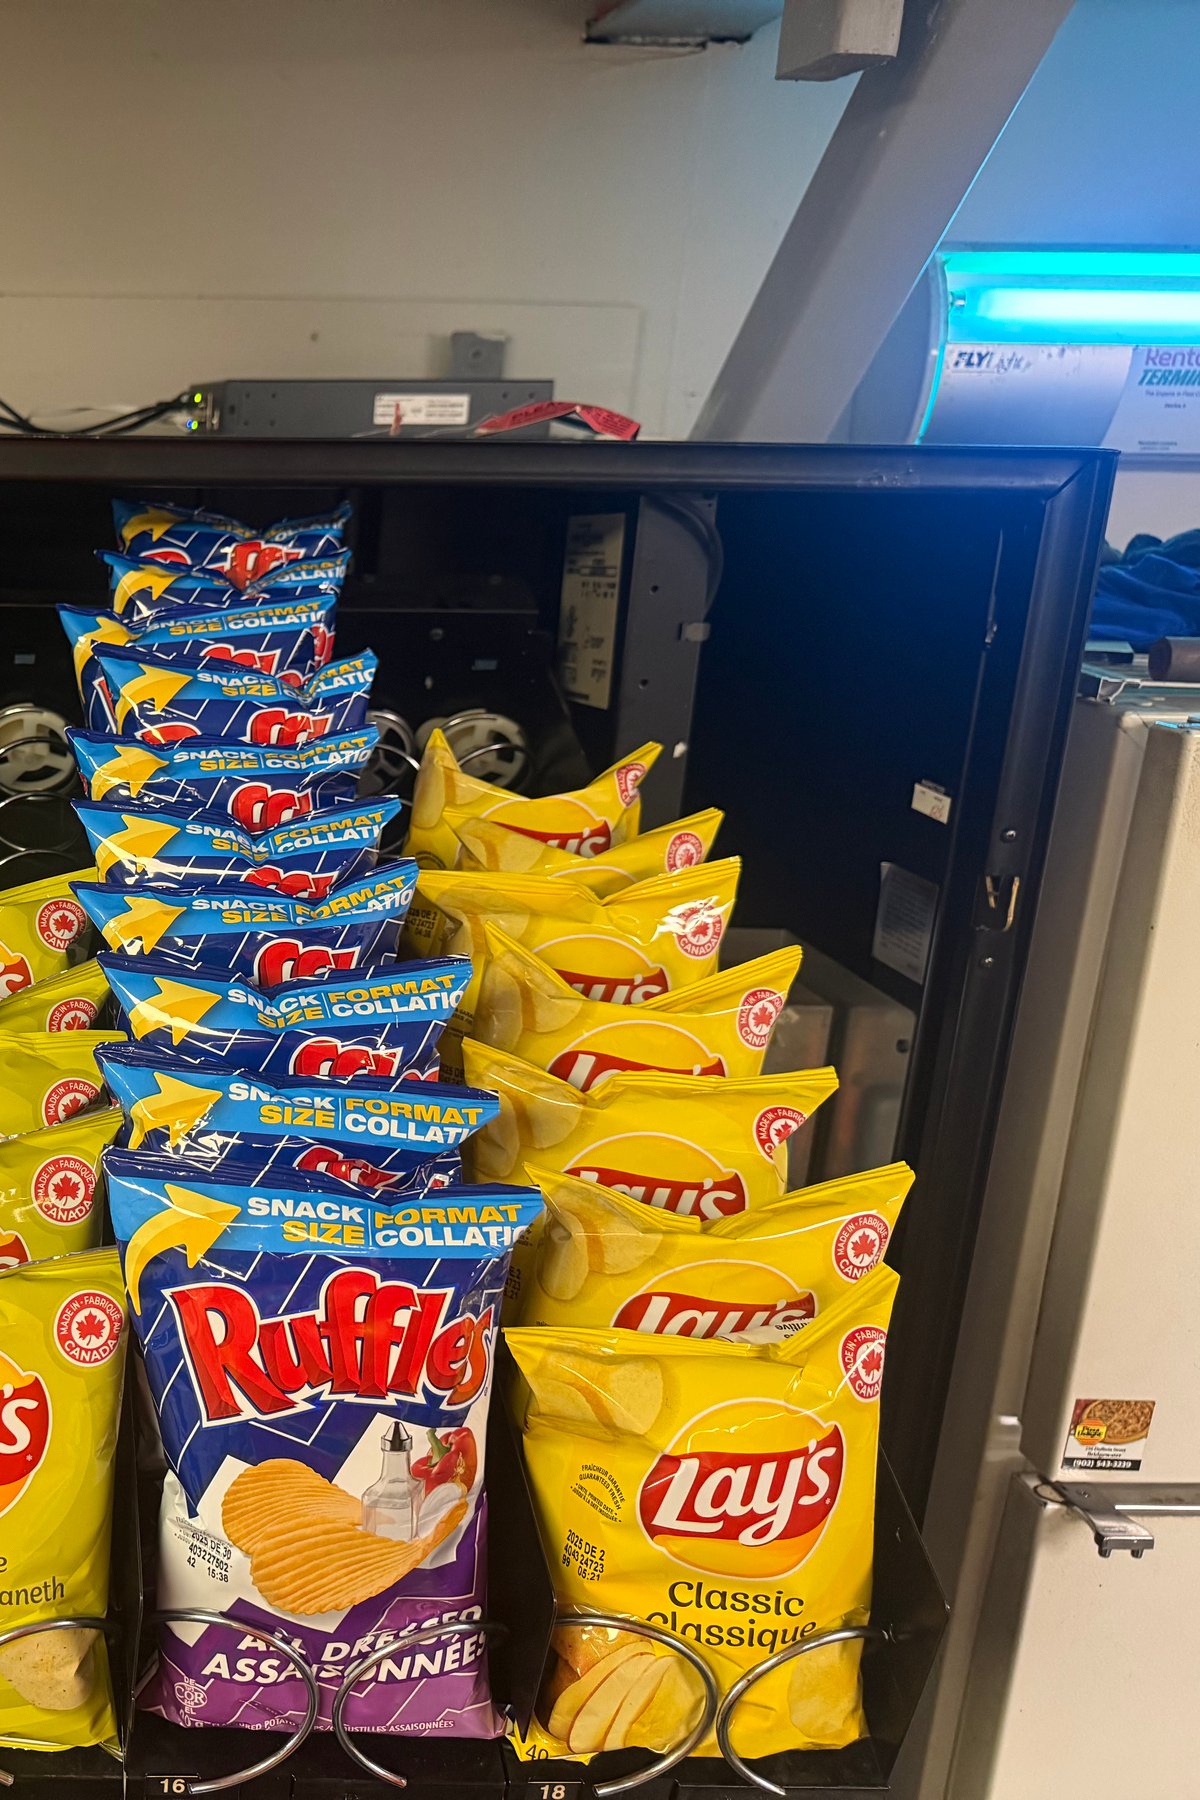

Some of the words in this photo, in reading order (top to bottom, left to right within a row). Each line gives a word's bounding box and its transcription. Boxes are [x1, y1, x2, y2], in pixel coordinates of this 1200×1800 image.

[225, 602, 322, 622] FORMAT
[169, 622, 223, 636] SIZE
[222, 683, 277, 697] SIZE
[173, 750, 257, 764] SNACK
[265, 737, 368, 762] FORMAT
[200, 758, 260, 771] SIZE
[273, 810, 385, 846] FORMAT
[192, 900, 287, 914] SNACK
[295, 875, 408, 920] FORMAT
[221, 910, 288, 925] SIZE
[227, 989, 320, 1019] SNACK
[328, 974, 456, 1004] FORMAT
[257, 1005, 325, 1030] SIZE
[47, 1091, 60, 1116] MADE
[228, 1082, 334, 1110] SNACK
[345, 1098, 483, 1126] FORMAT
[259, 1106, 336, 1129] SIZE
[37, 1168, 51, 1196] MADE
[41, 1199, 93, 1222] CANADA
[247, 1197, 365, 1224] SNACK
[375, 1204, 523, 1230] FORMAT
[282, 1221, 366, 1246] SIZE
[837, 1229, 851, 1256] MADE
[59, 1308, 75, 1335] MADE
[70, 1300, 81, 1312] IN
[84, 1295, 121, 1322] FABRIQUÉ
[113, 1320, 121, 1334] AU
[64, 1338, 118, 1363] CANADA
[168, 1267, 494, 1421] Ruffles
[651, 1438, 836, 1546] Lay's
[210, 1540, 221, 1555] DE
[222, 1546, 232, 1561] 30
[566, 1529, 584, 1551] 2025
[584, 1541, 598, 1559] DE
[598, 1549, 606, 1562] 2
[187, 1555, 197, 1569] 42
[207, 1566, 229, 1584] 15:38
[561, 1553, 571, 1568] 99
[577, 1565, 601, 1581] 05:21
[668, 1580, 805, 1617] Classic
[159, 1777, 186, 1794] 16
[540, 1783, 566, 1800] 18
